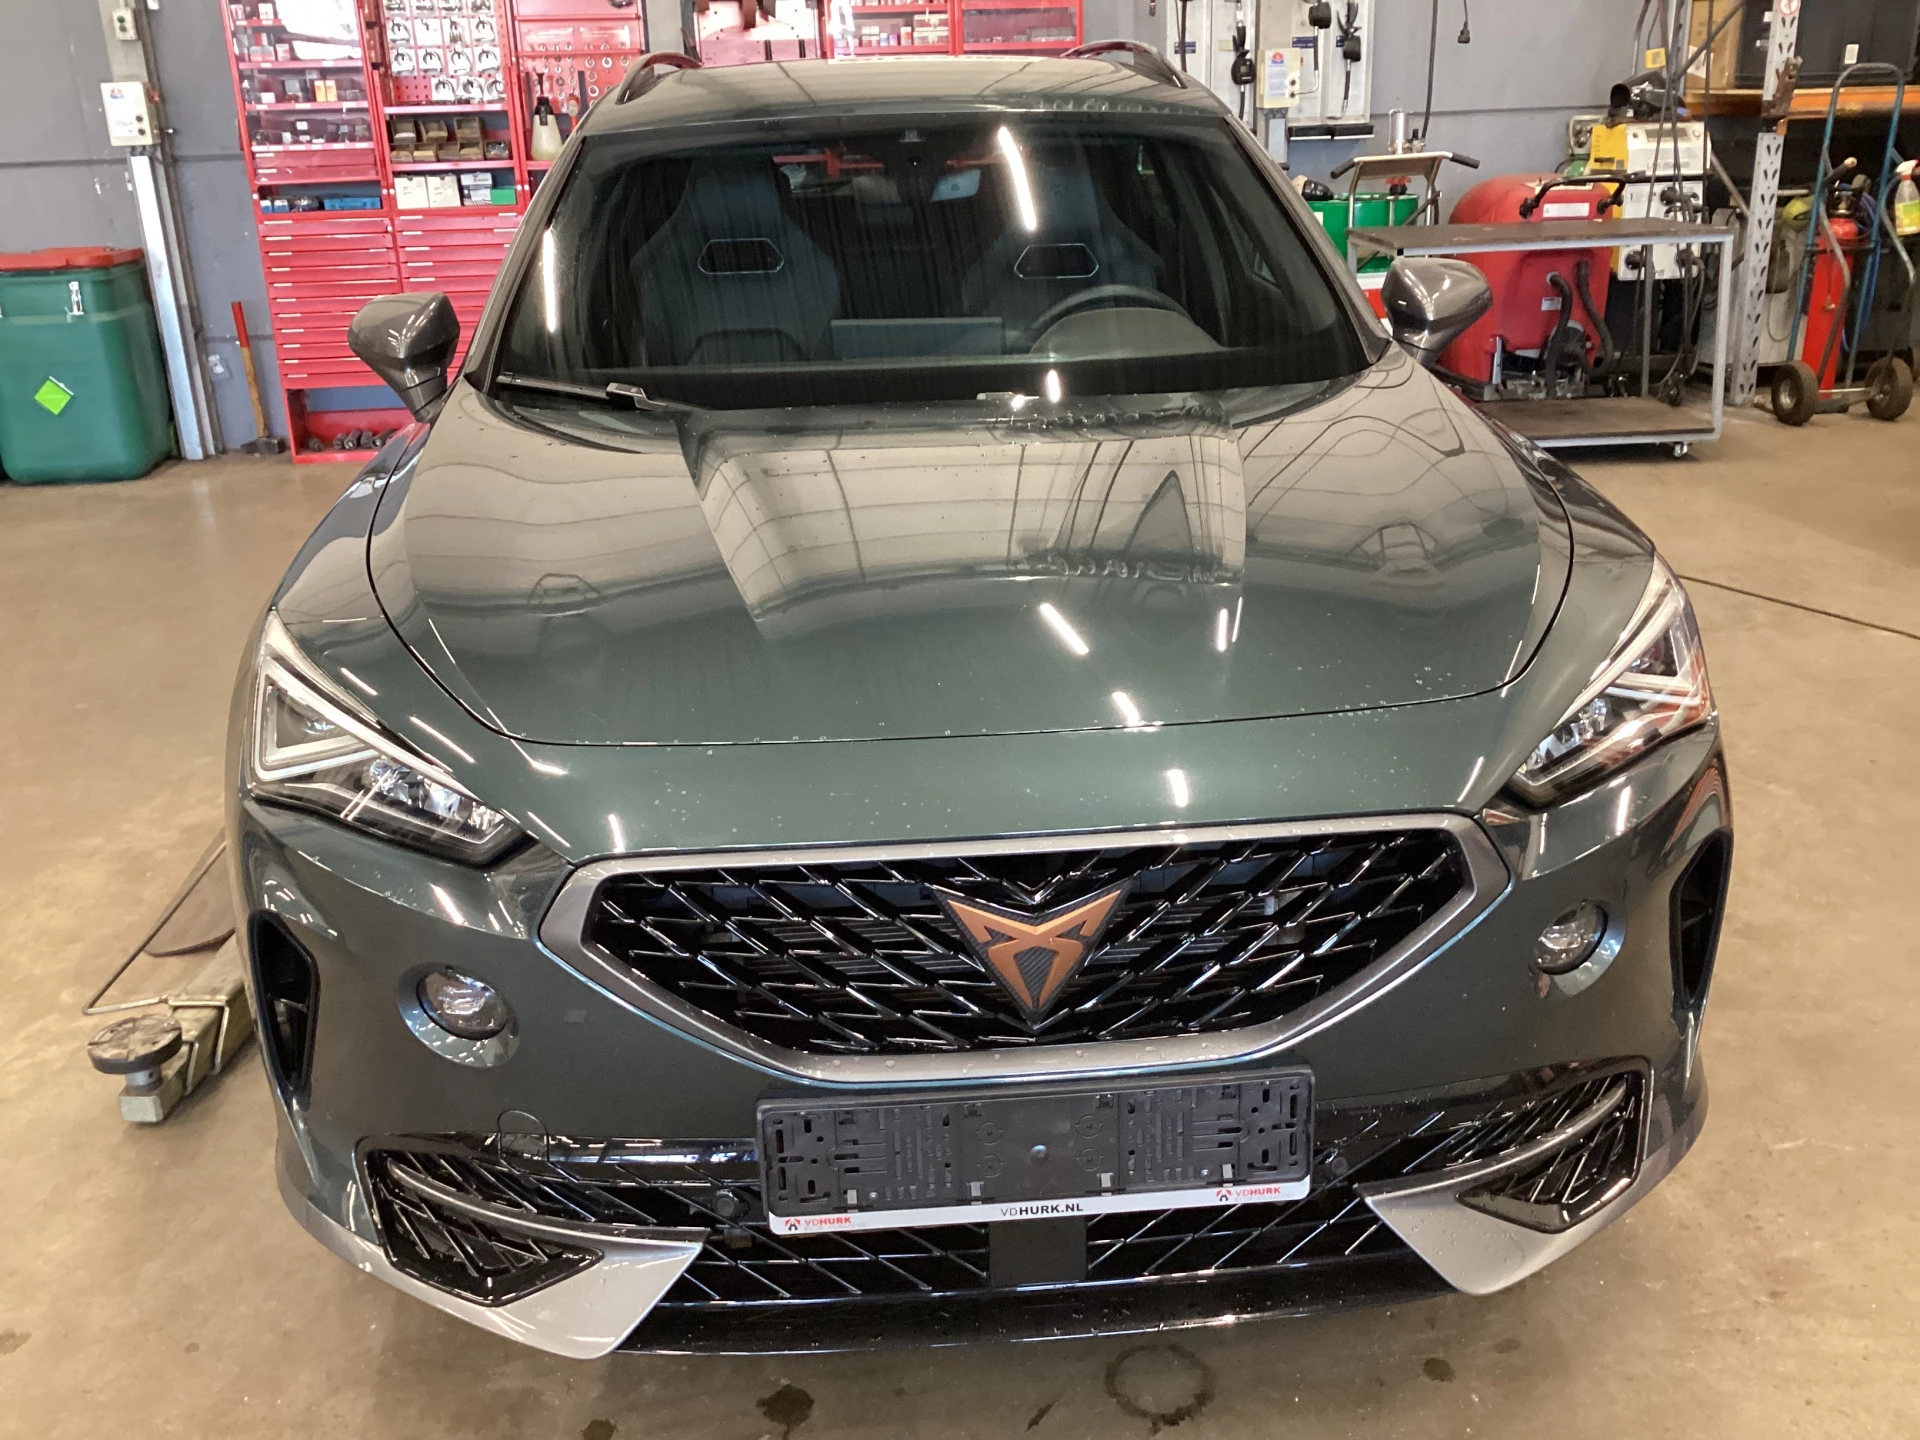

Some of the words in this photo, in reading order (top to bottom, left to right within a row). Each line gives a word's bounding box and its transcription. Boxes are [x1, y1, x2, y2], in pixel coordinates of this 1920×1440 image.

[1235, 1187, 1281, 1197] VDHURK
[1000, 1203, 1084, 1217] VDHURK.NL
[804, 1216, 852, 1226] VDHURK
